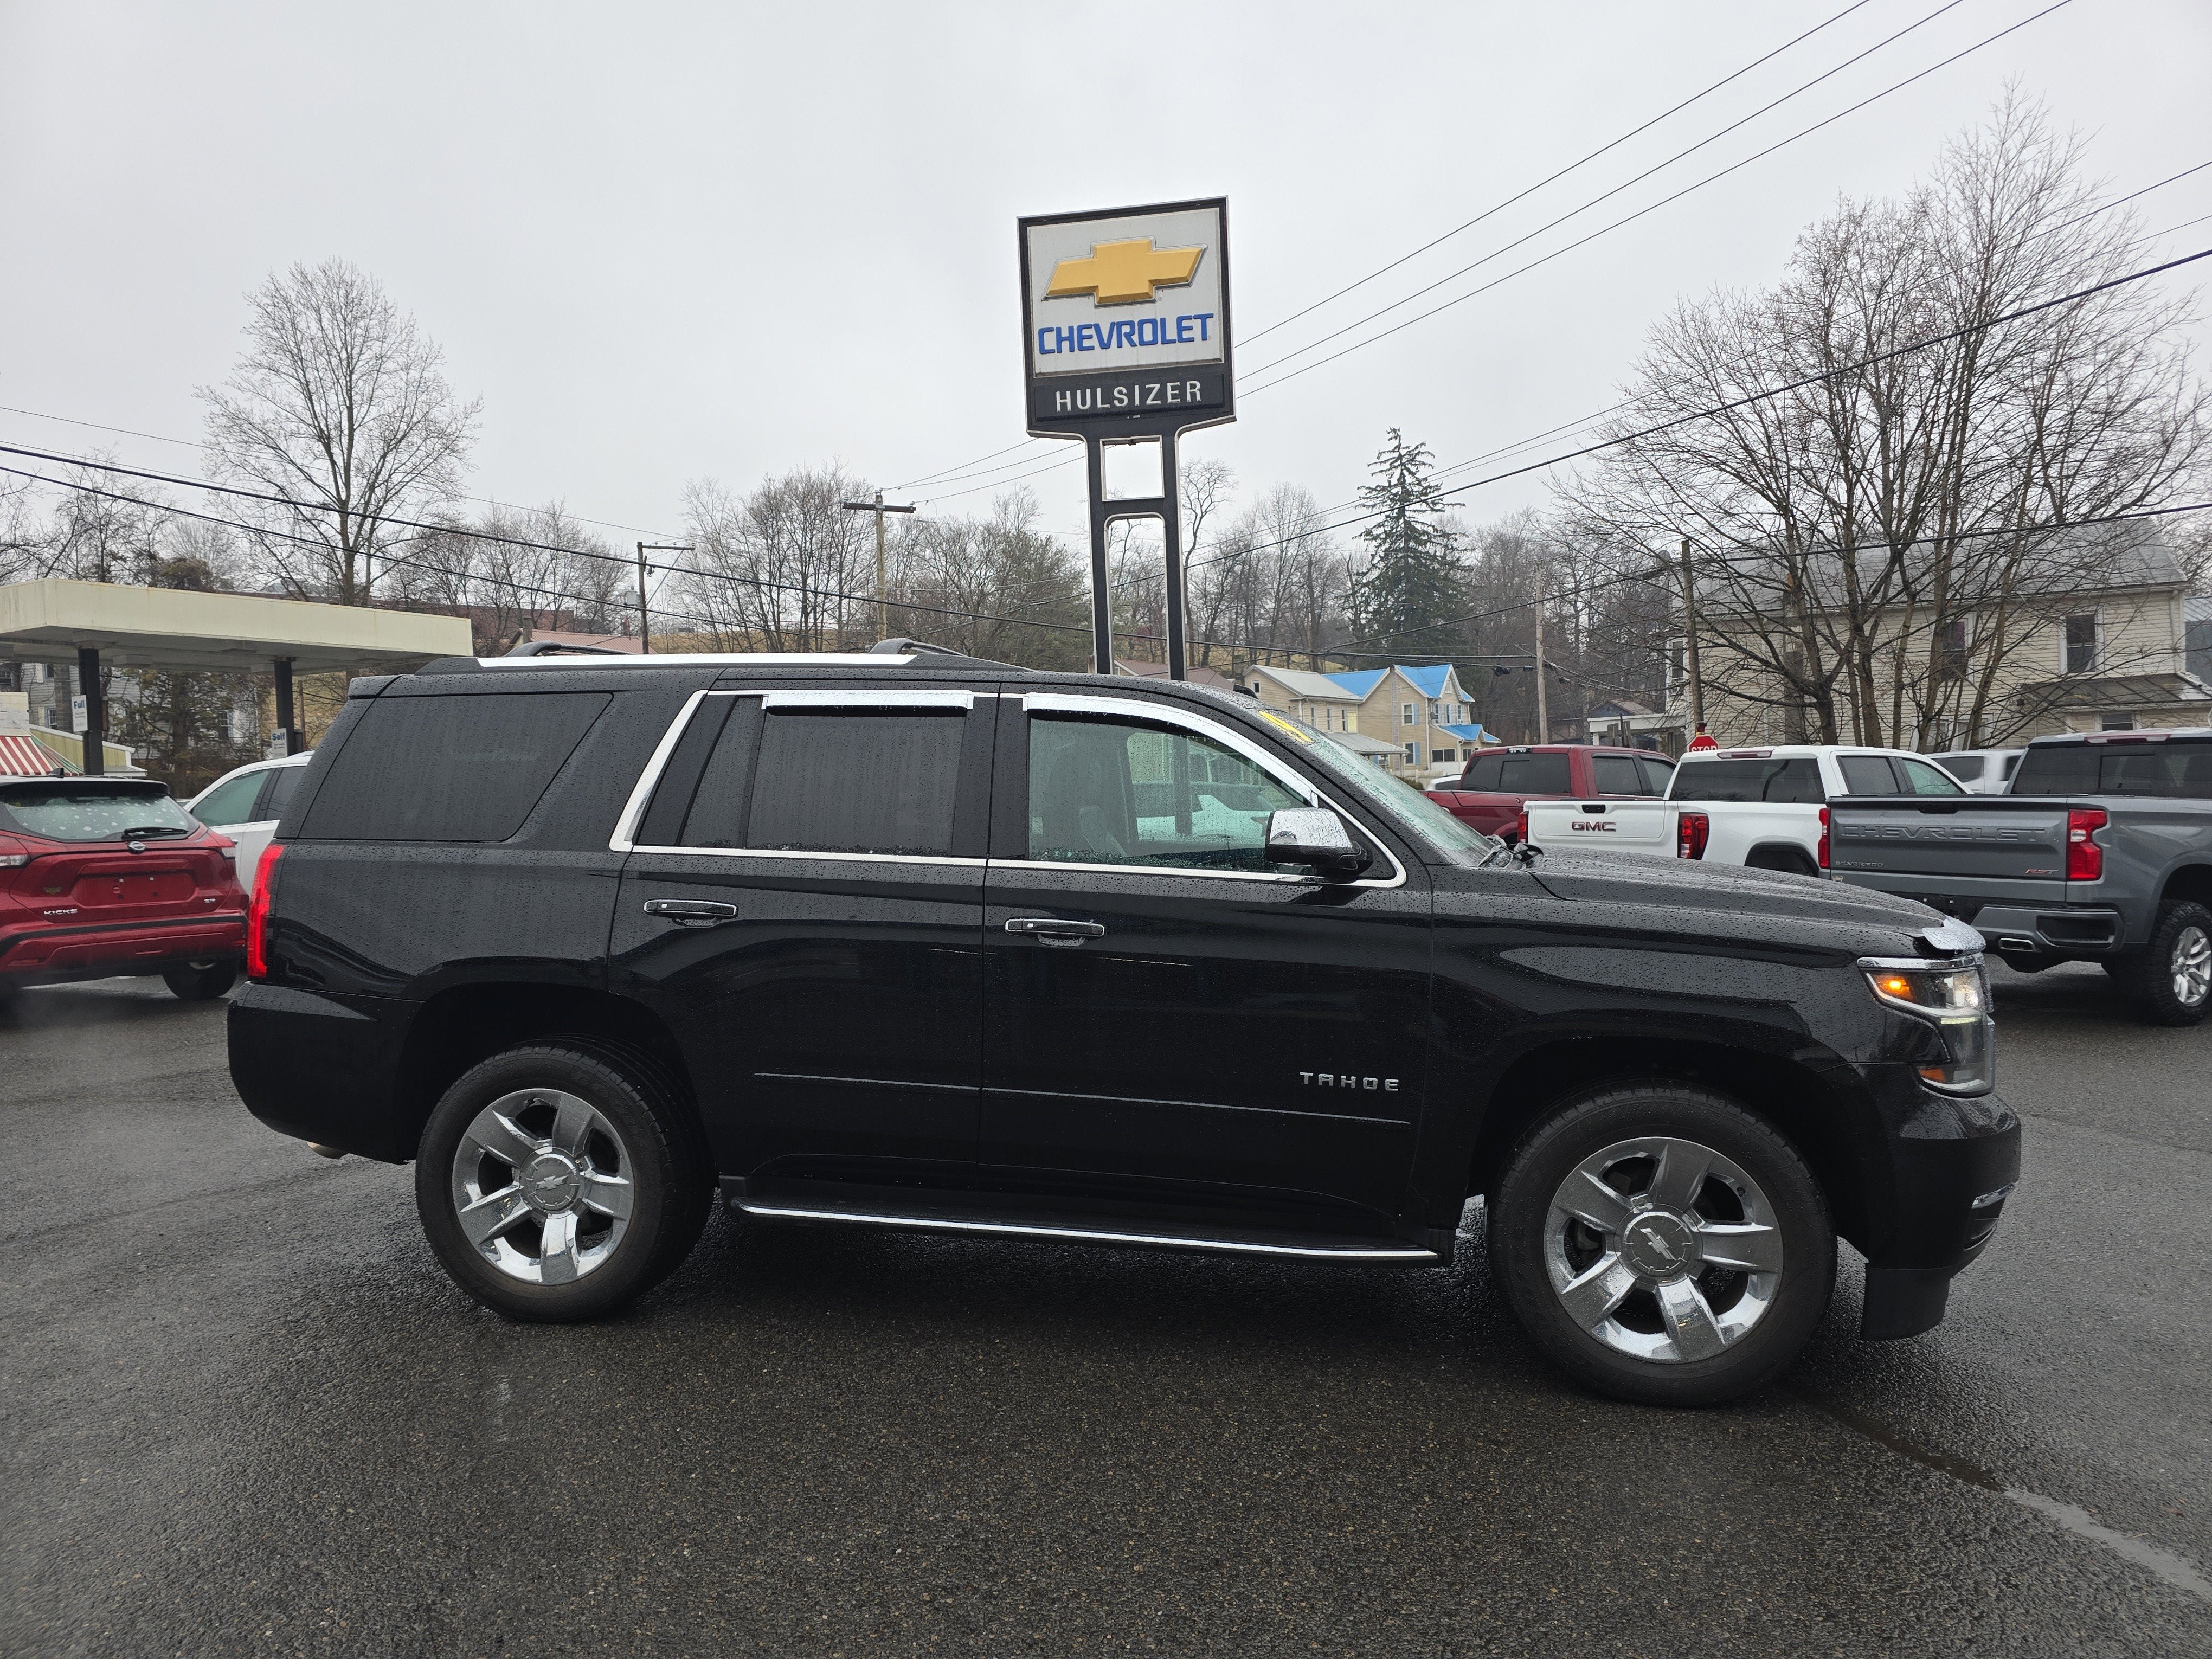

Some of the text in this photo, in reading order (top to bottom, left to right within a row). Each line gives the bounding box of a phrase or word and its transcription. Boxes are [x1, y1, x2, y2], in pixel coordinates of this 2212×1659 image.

[1038, 313, 1214, 355] CHEVROLET
[1056, 381, 1201, 412] HULSIZER
[74, 700, 85, 709] Full
[272, 732, 285, 741] Self
[1572, 822, 1616, 832] GMC
[1842, 826, 2046, 841] CHEVROLET
[1300, 1072, 1399, 1091] TAHOE
